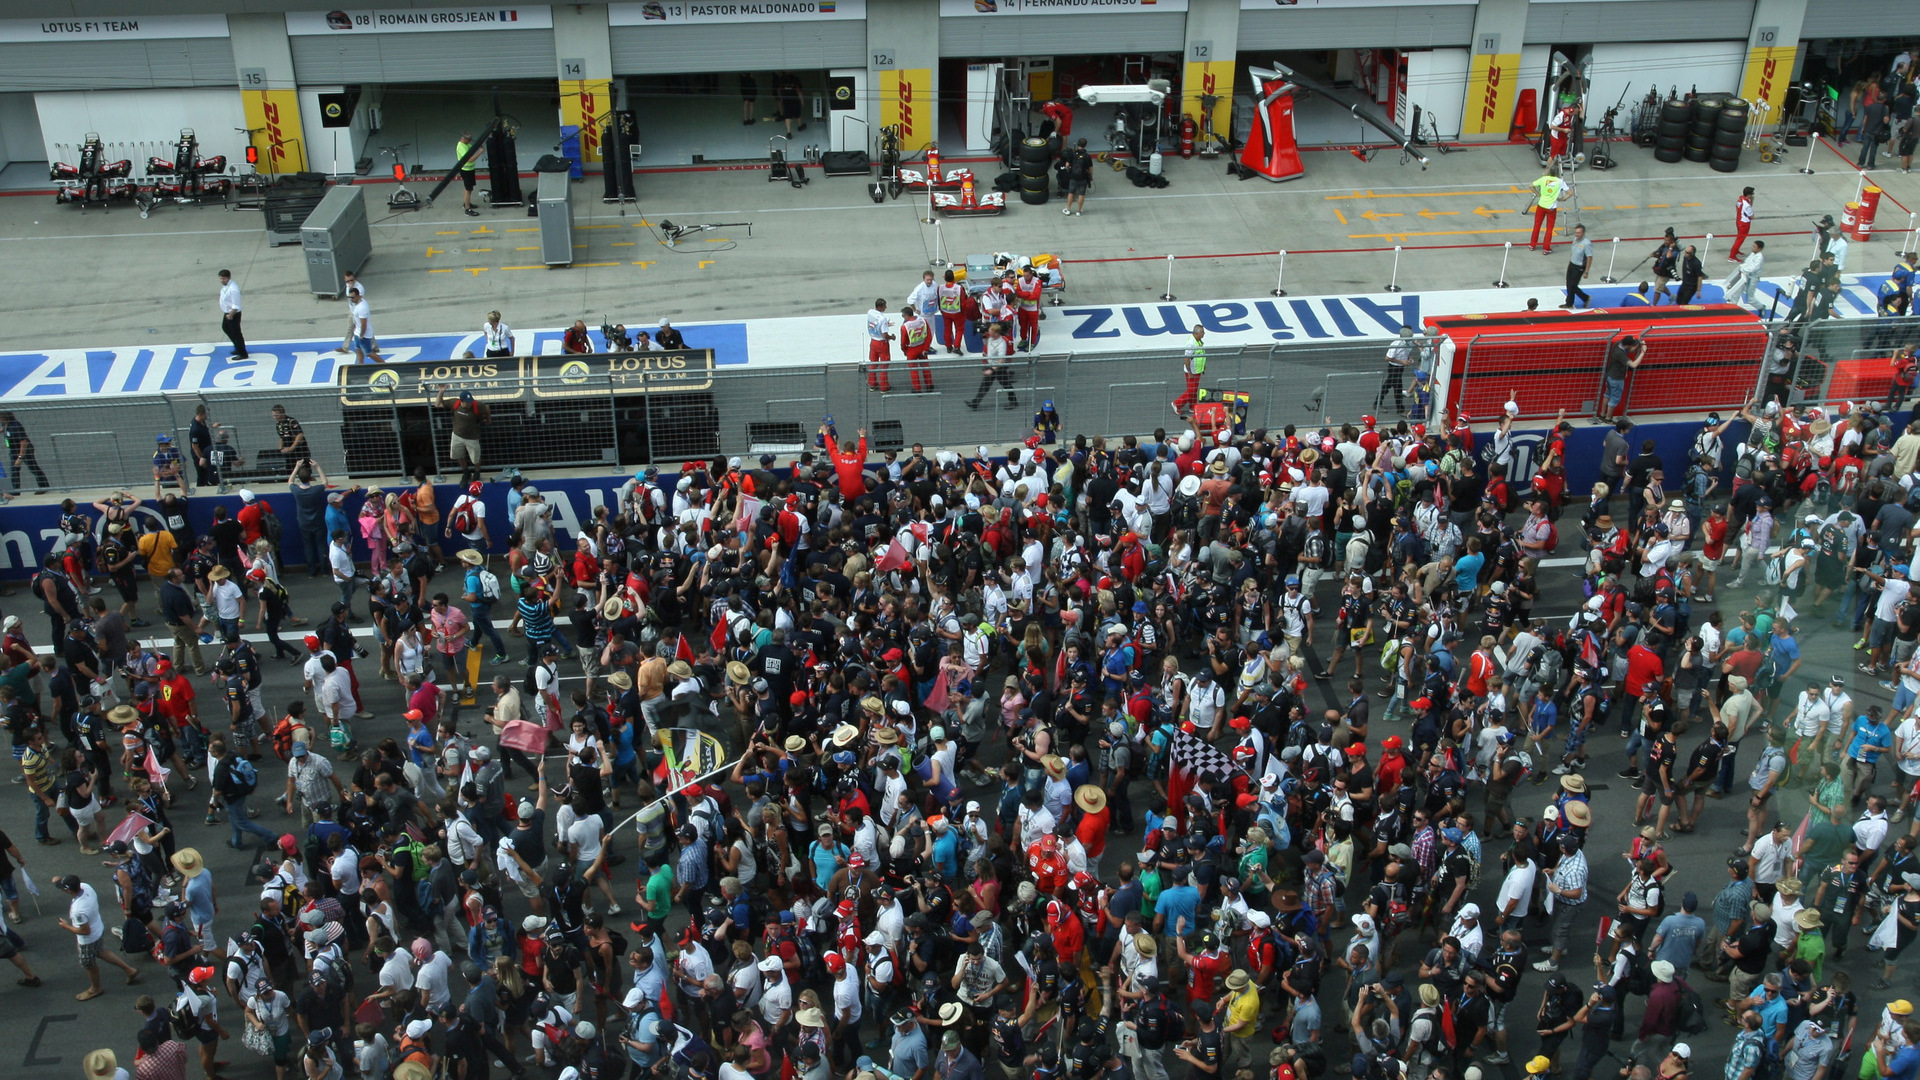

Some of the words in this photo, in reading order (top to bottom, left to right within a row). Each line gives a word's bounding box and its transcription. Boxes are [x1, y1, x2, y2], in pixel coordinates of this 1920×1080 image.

[668, 6, 682, 16] 13
[691, 5, 737, 16] PASTOR
[740, 3, 815, 14] MALDONADO
[355, 15, 370, 25] 08
[379, 13, 428, 25] ROMAIN
[431, 11, 496, 23] GROSJEAN
[41, 23, 82, 33] LOTUS
[86, 22, 99, 32] F1
[103, 21, 139, 32] TEAM
[1761, 31, 1774, 42] 10
[1484, 39, 1494, 49] 11
[1194, 46, 1208, 56] 12
[873, 54, 893, 65] 12a
[565, 64, 580, 74] 14
[245, 73, 261, 84] 15
[1482, 65, 1501, 123] DHL
[899, 80, 912, 140] DHL
[580, 91, 598, 151] DHL
[263, 101, 285, 163] DHL
[1062, 295, 1424, 340] Allianz
[608, 356, 687, 371] LOTUS
[418, 364, 498, 380] LOTUS
